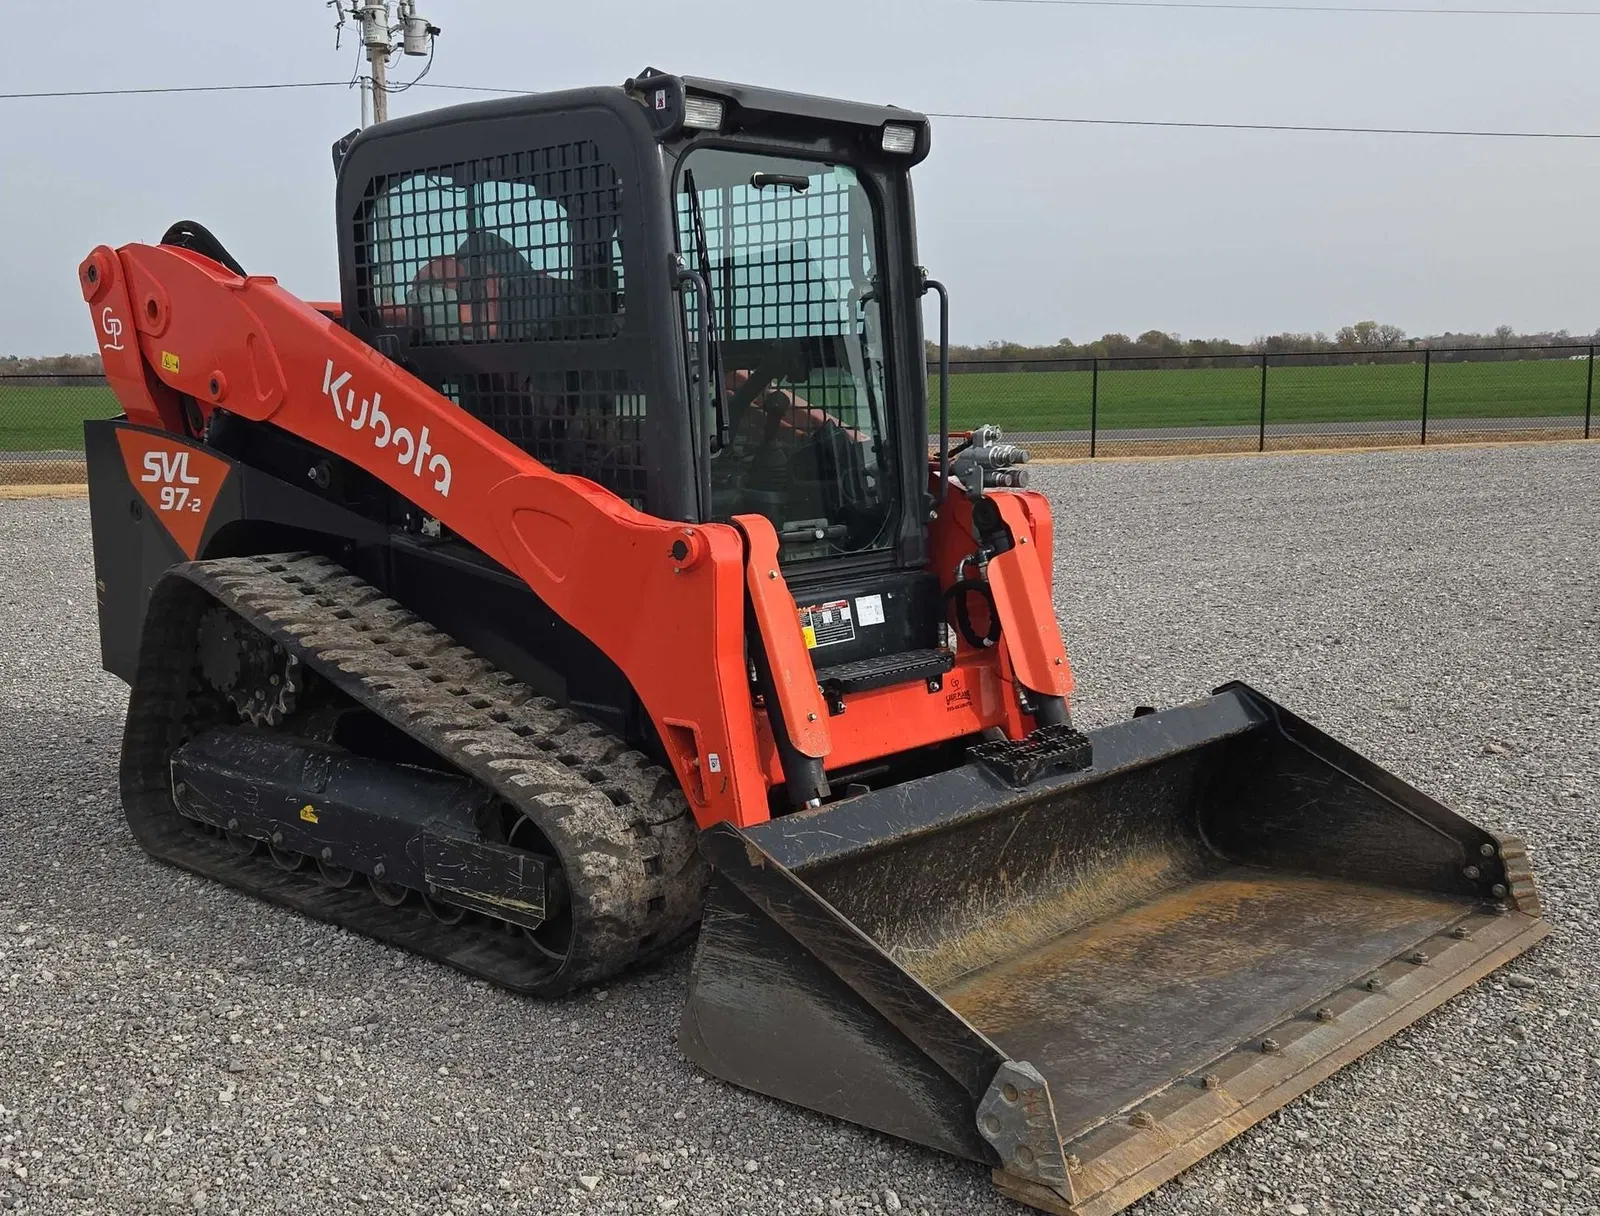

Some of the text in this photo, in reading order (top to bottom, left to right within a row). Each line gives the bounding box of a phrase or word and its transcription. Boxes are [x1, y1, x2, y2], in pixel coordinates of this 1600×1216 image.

[323, 358, 452, 498] Kubota
[141, 451, 200, 484] SVL
[160, 486, 201, 513] 97-2
